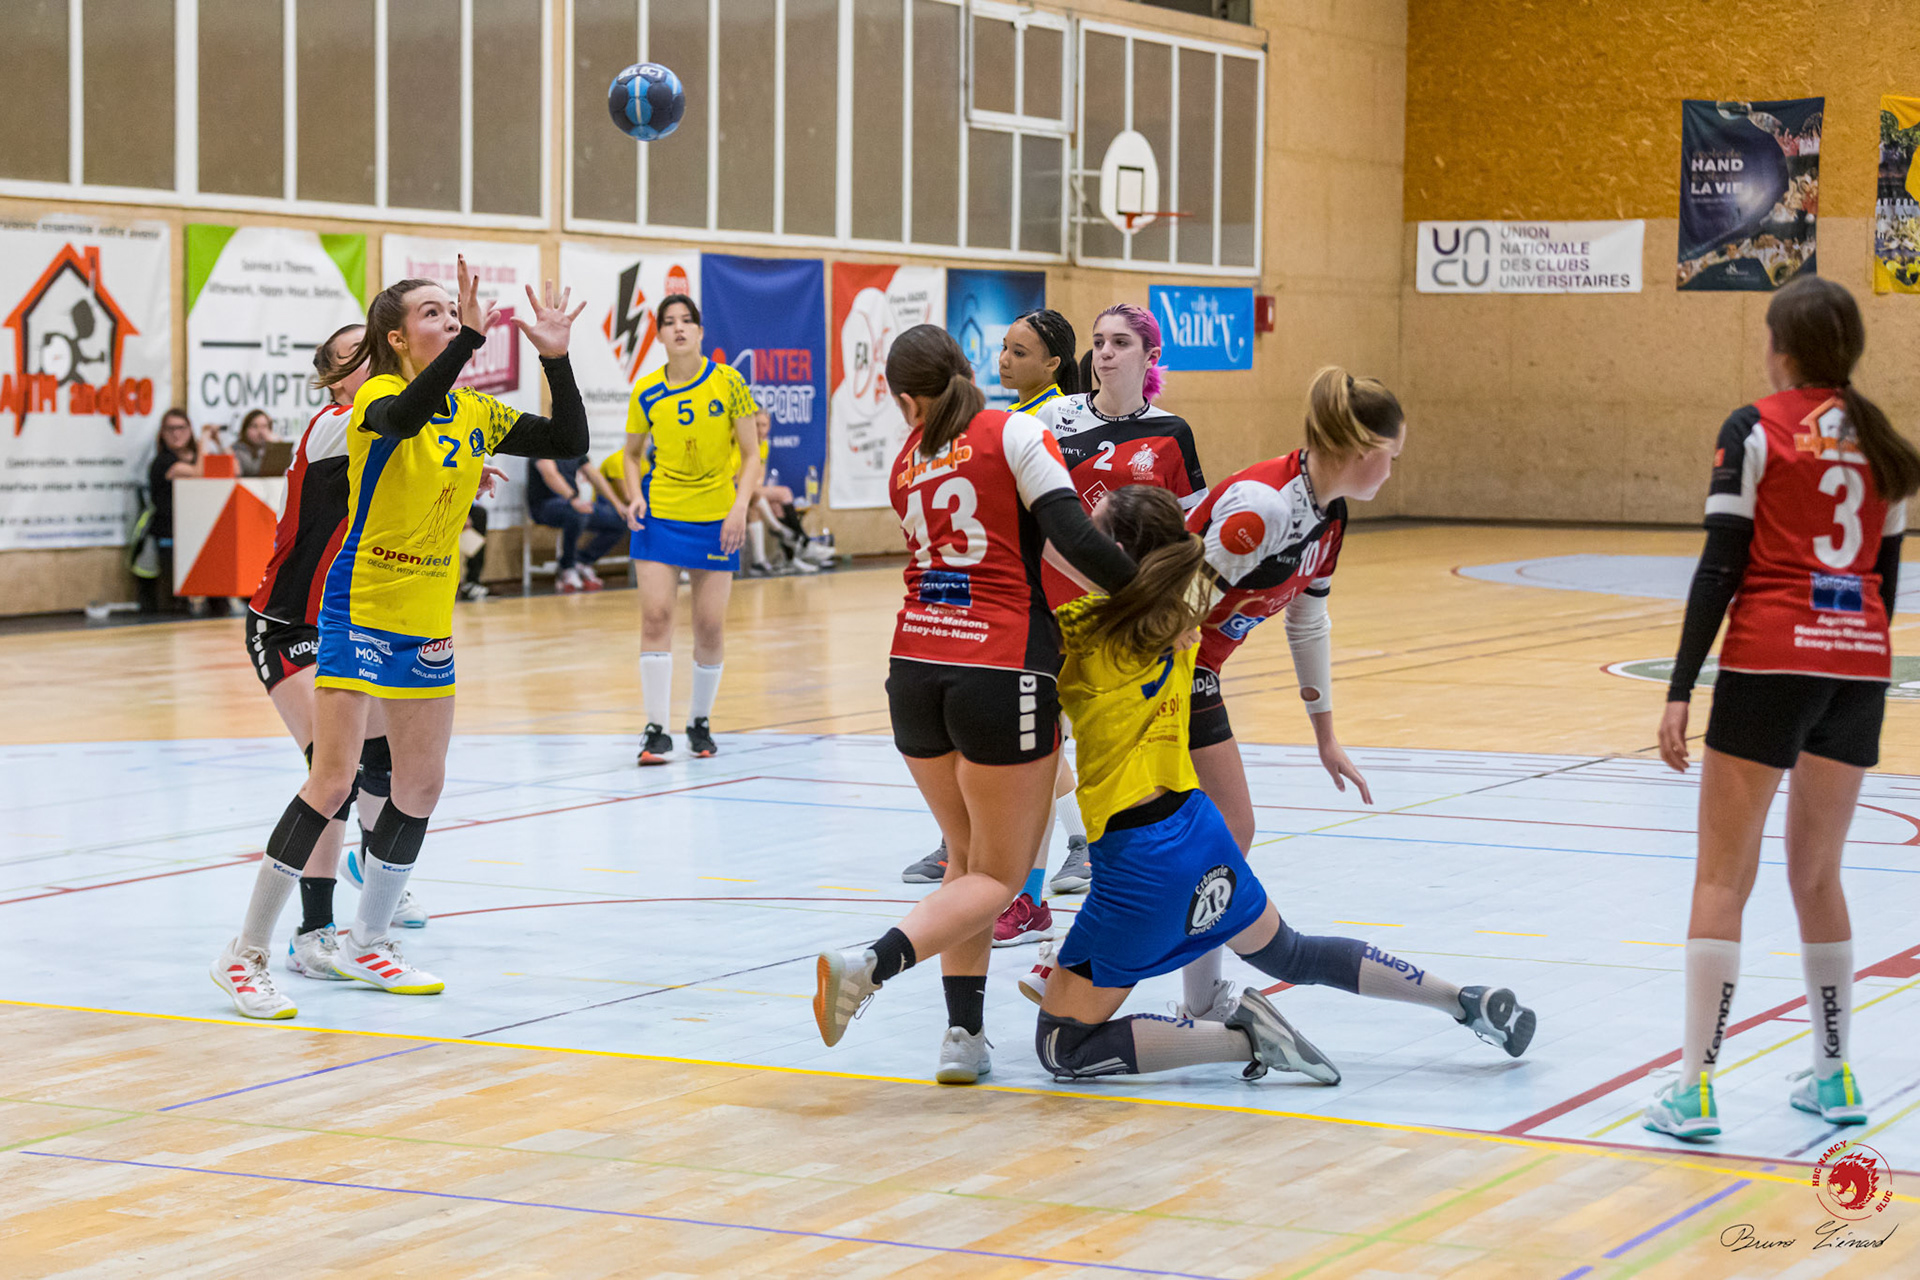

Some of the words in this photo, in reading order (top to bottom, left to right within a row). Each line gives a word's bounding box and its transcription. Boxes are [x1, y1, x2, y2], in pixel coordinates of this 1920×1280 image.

[1691, 158, 1744, 172] HAND
[1690, 182, 1713, 195] LA
[1714, 182, 1743, 195] VIE
[1500, 226, 1550, 239] UNION
[1500, 241, 1591, 256] NATIONALE
[1500, 258, 1531, 272] DES
[1535, 258, 1590, 272] CLUBS
[1500, 273, 1631, 289] UNIVERSITAIRES
[267, 334, 289, 357] LE
[753, 348, 812, 382] INTER
[201, 372, 330, 407] COMPTO
[677, 399, 695, 426] 5
[752, 384, 816, 424] SPORT
[1055, 424, 1077, 433] erima
[438, 435, 461, 468] 2
[1060, 446, 1087, 458] ancy
[1093, 440, 1116, 471] 2
[901, 476, 988, 569] 13
[1812, 465, 1865, 569] 3
[1236, 527, 1258, 549] Crou
[367, 558, 395, 572] DECIDE
[396, 566, 415, 576] WITH
[1297, 540, 1320, 575] 10
[905, 610, 989, 630] Neuves-Maisons
[902, 622, 988, 643] Essey-lès-Nancy
[272, 862, 301, 879] Kem
[382, 863, 414, 873] Kem
[1362, 944, 1425, 986] Kemp
[1703, 982, 1735, 1065] Kempa
[1820, 985, 1842, 1059] Kempa
